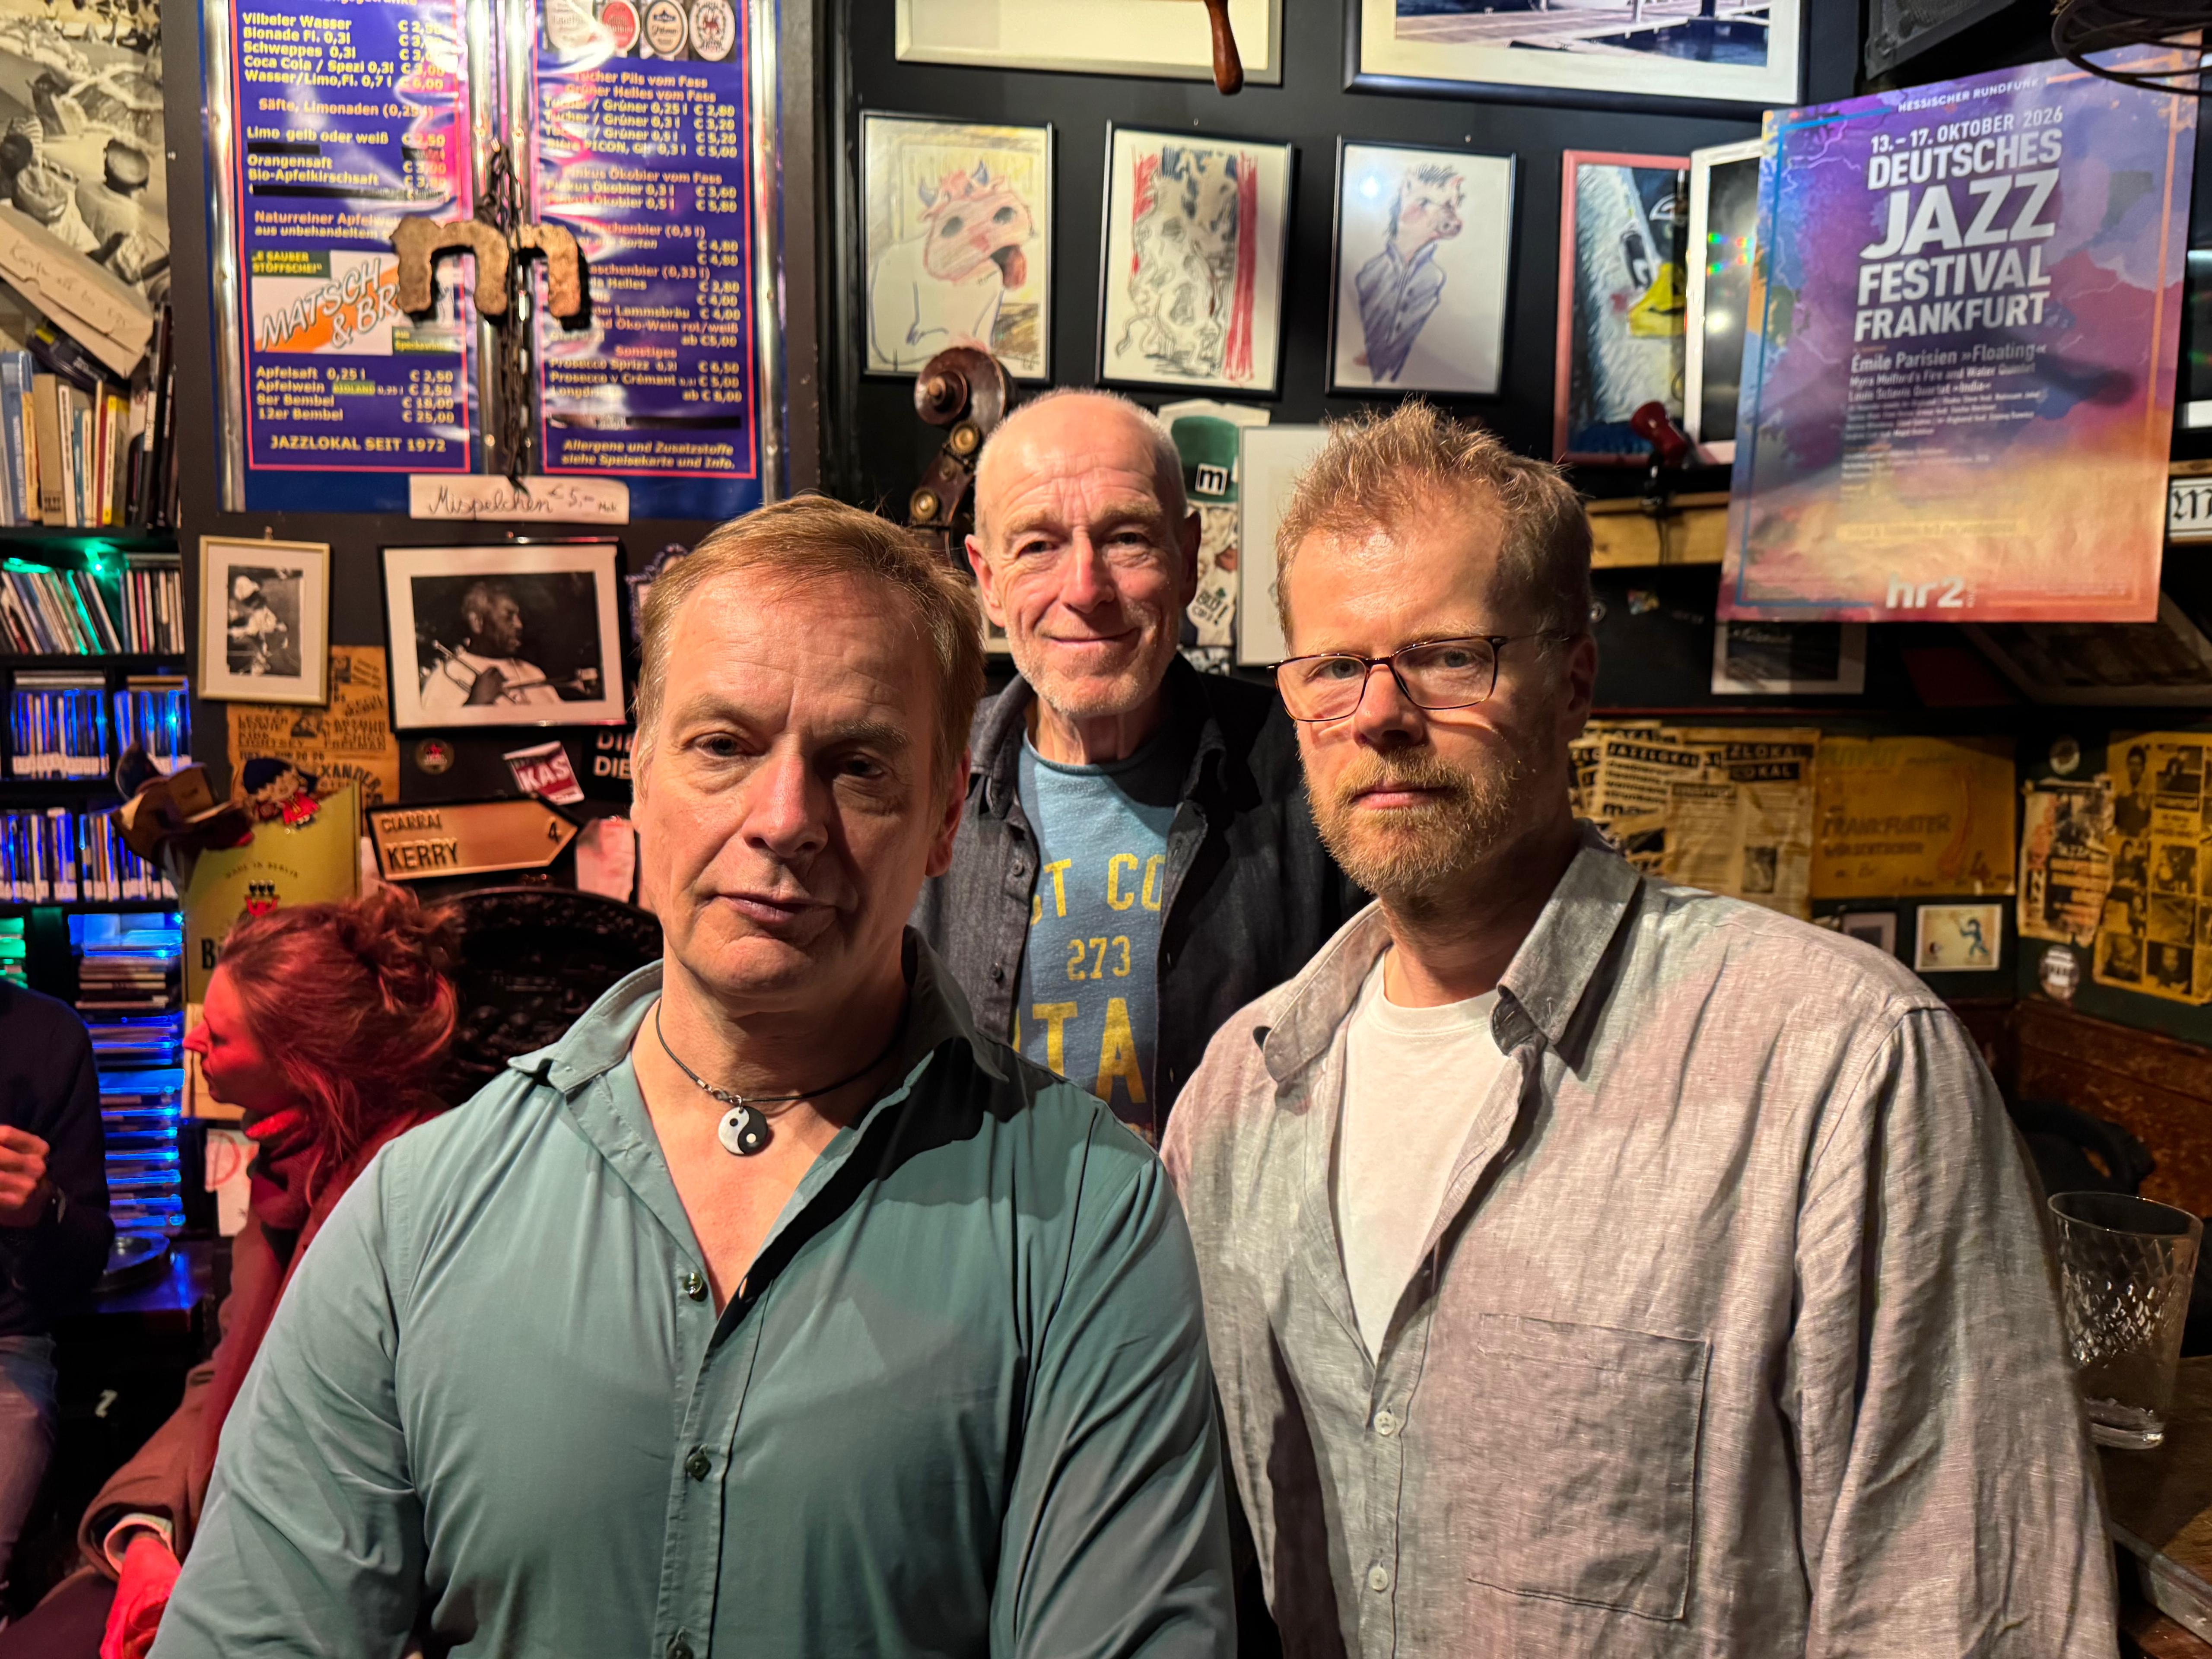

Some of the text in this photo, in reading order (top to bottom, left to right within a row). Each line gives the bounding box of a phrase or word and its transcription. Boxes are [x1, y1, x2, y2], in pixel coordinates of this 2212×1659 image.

[242, 12, 296, 26] Vilbeler
[299, 15, 352, 30] Wasser
[244, 26, 299, 41] Bionade
[244, 41, 322, 58] Schweppes
[244, 55, 277, 68] Coca
[281, 57, 311, 71] Cola
[328, 60, 364, 74] Spezi
[621, 72, 645, 85] Pils
[648, 76, 675, 86] vom
[678, 75, 708, 89] Fass
[613, 85, 654, 100] Helles
[656, 90, 684, 101] vom
[687, 89, 716, 103] Fass
[1898, 79, 2039, 113] HESSISCHER RUNDFUNK
[259, 98, 299, 114] Säfte,
[304, 100, 378, 116] Limonaden
[602, 99, 648, 113] Grüner
[651, 102, 680, 116] 0,25
[603, 112, 648, 127] Grüner
[651, 115, 672, 130] 0,3
[706, 118, 735, 132] 3,20
[1937, 114, 2014, 143] OKTOBER
[2023, 105, 2063, 130] 2026
[247, 125, 280, 140] Limo
[286, 128, 317, 143] gelb
[320, 130, 353, 143] oder
[356, 131, 389, 145] weiß
[603, 127, 648, 140] Grüner
[708, 132, 736, 146] 5,20
[247, 154, 333, 169] Orangensaft
[1867, 128, 2062, 190] DEUTSCHES
[248, 168, 379, 186] Bio-Apfelkirschsaft
[609, 165, 660, 182] Ökobier
[662, 172, 690, 183] vom
[693, 171, 722, 184] Fass
[592, 180, 643, 194] Ökobier
[594, 194, 643, 208] Ökobier
[255, 210, 334, 225] Naturreiner
[1859, 168, 2059, 259] JAZZ
[255, 226, 277, 236] aus
[280, 225, 378, 239] unbehandeltem
[266, 251, 309, 263] SAUBER
[590, 264, 659, 277] aschenbier
[1857, 245, 2051, 306] FESTIVAL
[607, 278, 647, 290] Helles
[261, 257, 381, 352] MATSCH
[615, 305, 690, 319] Lammsbräu
[1853, 290, 2050, 342] FRANKFURT
[615, 317, 738, 334] Öko-Wein rot/weiß
[681, 334, 698, 346] ab
[615, 344, 677, 359] Sonstiges
[549, 358, 607, 369] Prosecco
[256, 365, 453, 384] Apfelsaft 0,25 2,50
[549, 371, 607, 383] Prosecco
[621, 372, 676, 386] Crémant
[256, 379, 325, 394] Apfelwein
[423, 383, 452, 397] 2,50
[682, 389, 699, 401] ab
[283, 393, 334, 407] Bembel
[258, 407, 454, 424] 12er Bembel 25,00
[270, 435, 446, 452] JAZZLOKAL SEIT 1972
[564, 439, 734, 456] Allergene und Zusatzstoffe
[562, 453, 596, 465] siehe
[599, 454, 674, 467] Speisekarte
[677, 457, 702, 468] und
[1200, 469, 1225, 491] m
[1886, 572, 1964, 609] hr2
[385, 837, 459, 870] KERRY
[1107, 853, 1165, 912] CO
[1067, 935, 1131, 981] 273
[1013, 997, 1146, 1104] TA
